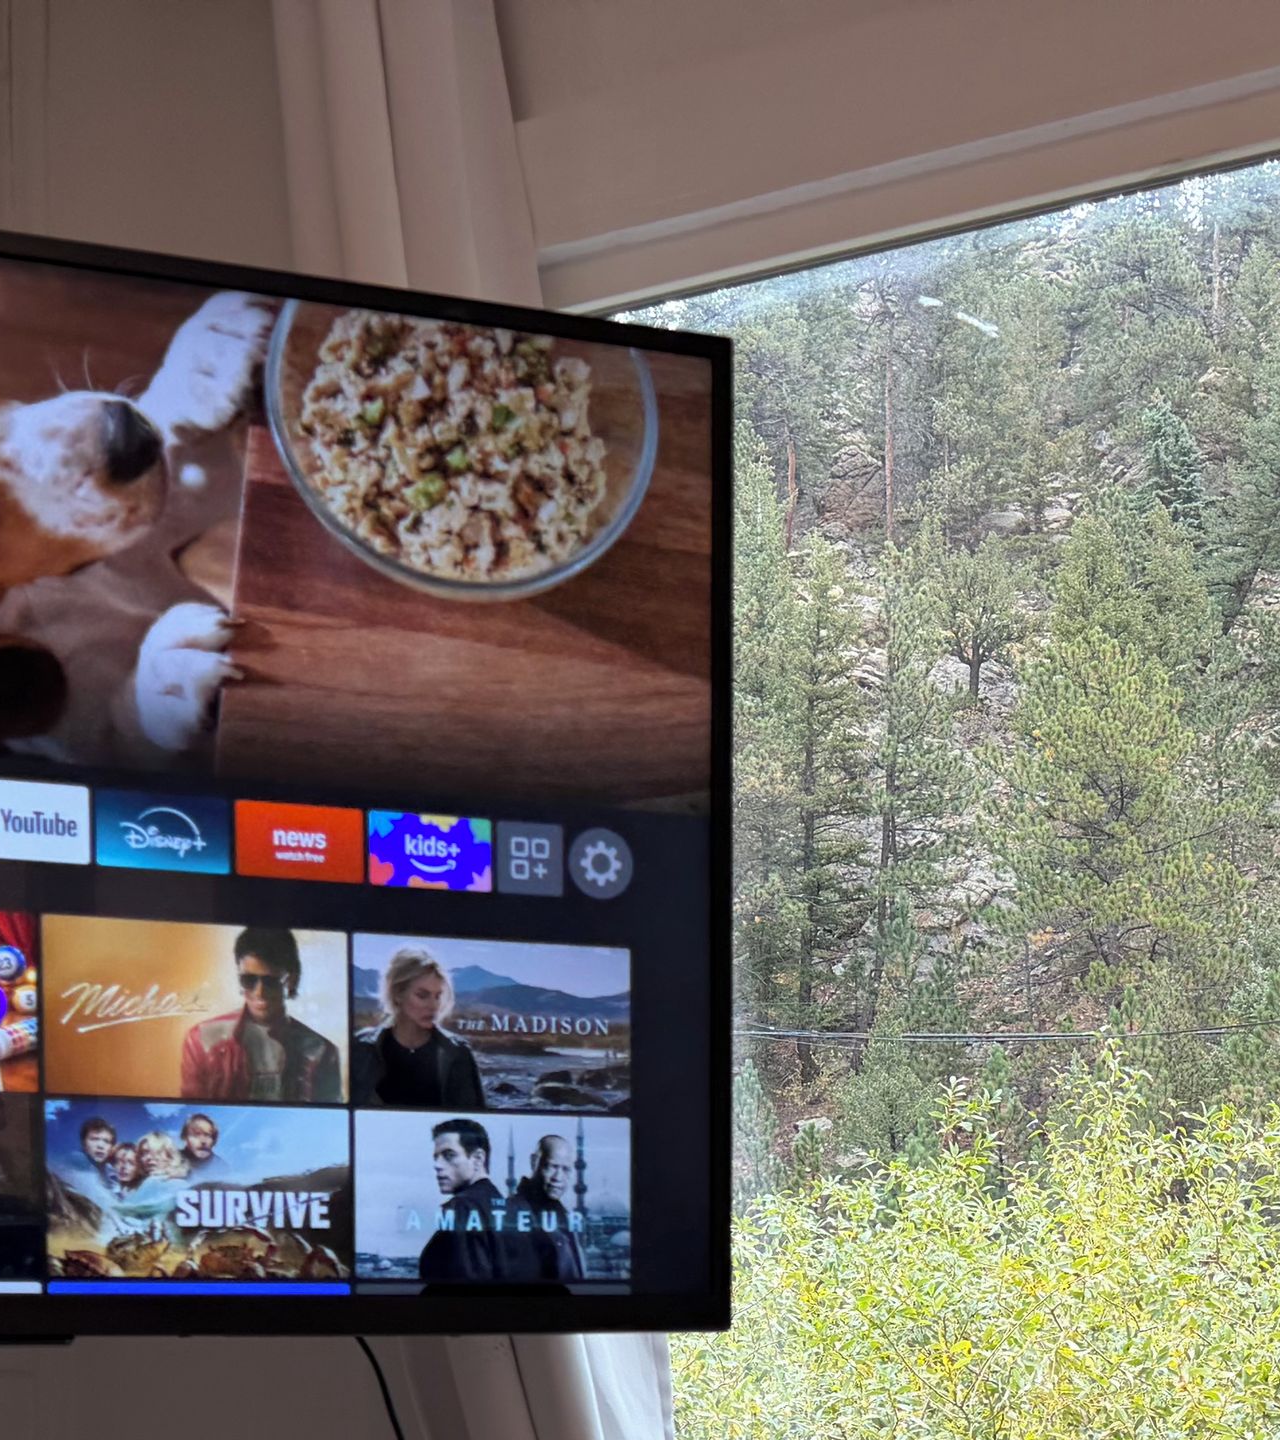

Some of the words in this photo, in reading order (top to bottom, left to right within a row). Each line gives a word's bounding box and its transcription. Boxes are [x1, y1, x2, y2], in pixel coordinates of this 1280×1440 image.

[0, 808, 78, 838] YouTube
[273, 829, 327, 849] news
[404, 833, 460, 858] kids+
[61, 982, 208, 1024] Micha
[491, 1014, 609, 1036] MADISON
[176, 1190, 330, 1229] SURVIVE
[406, 1210, 586, 1232] AMATEUR
